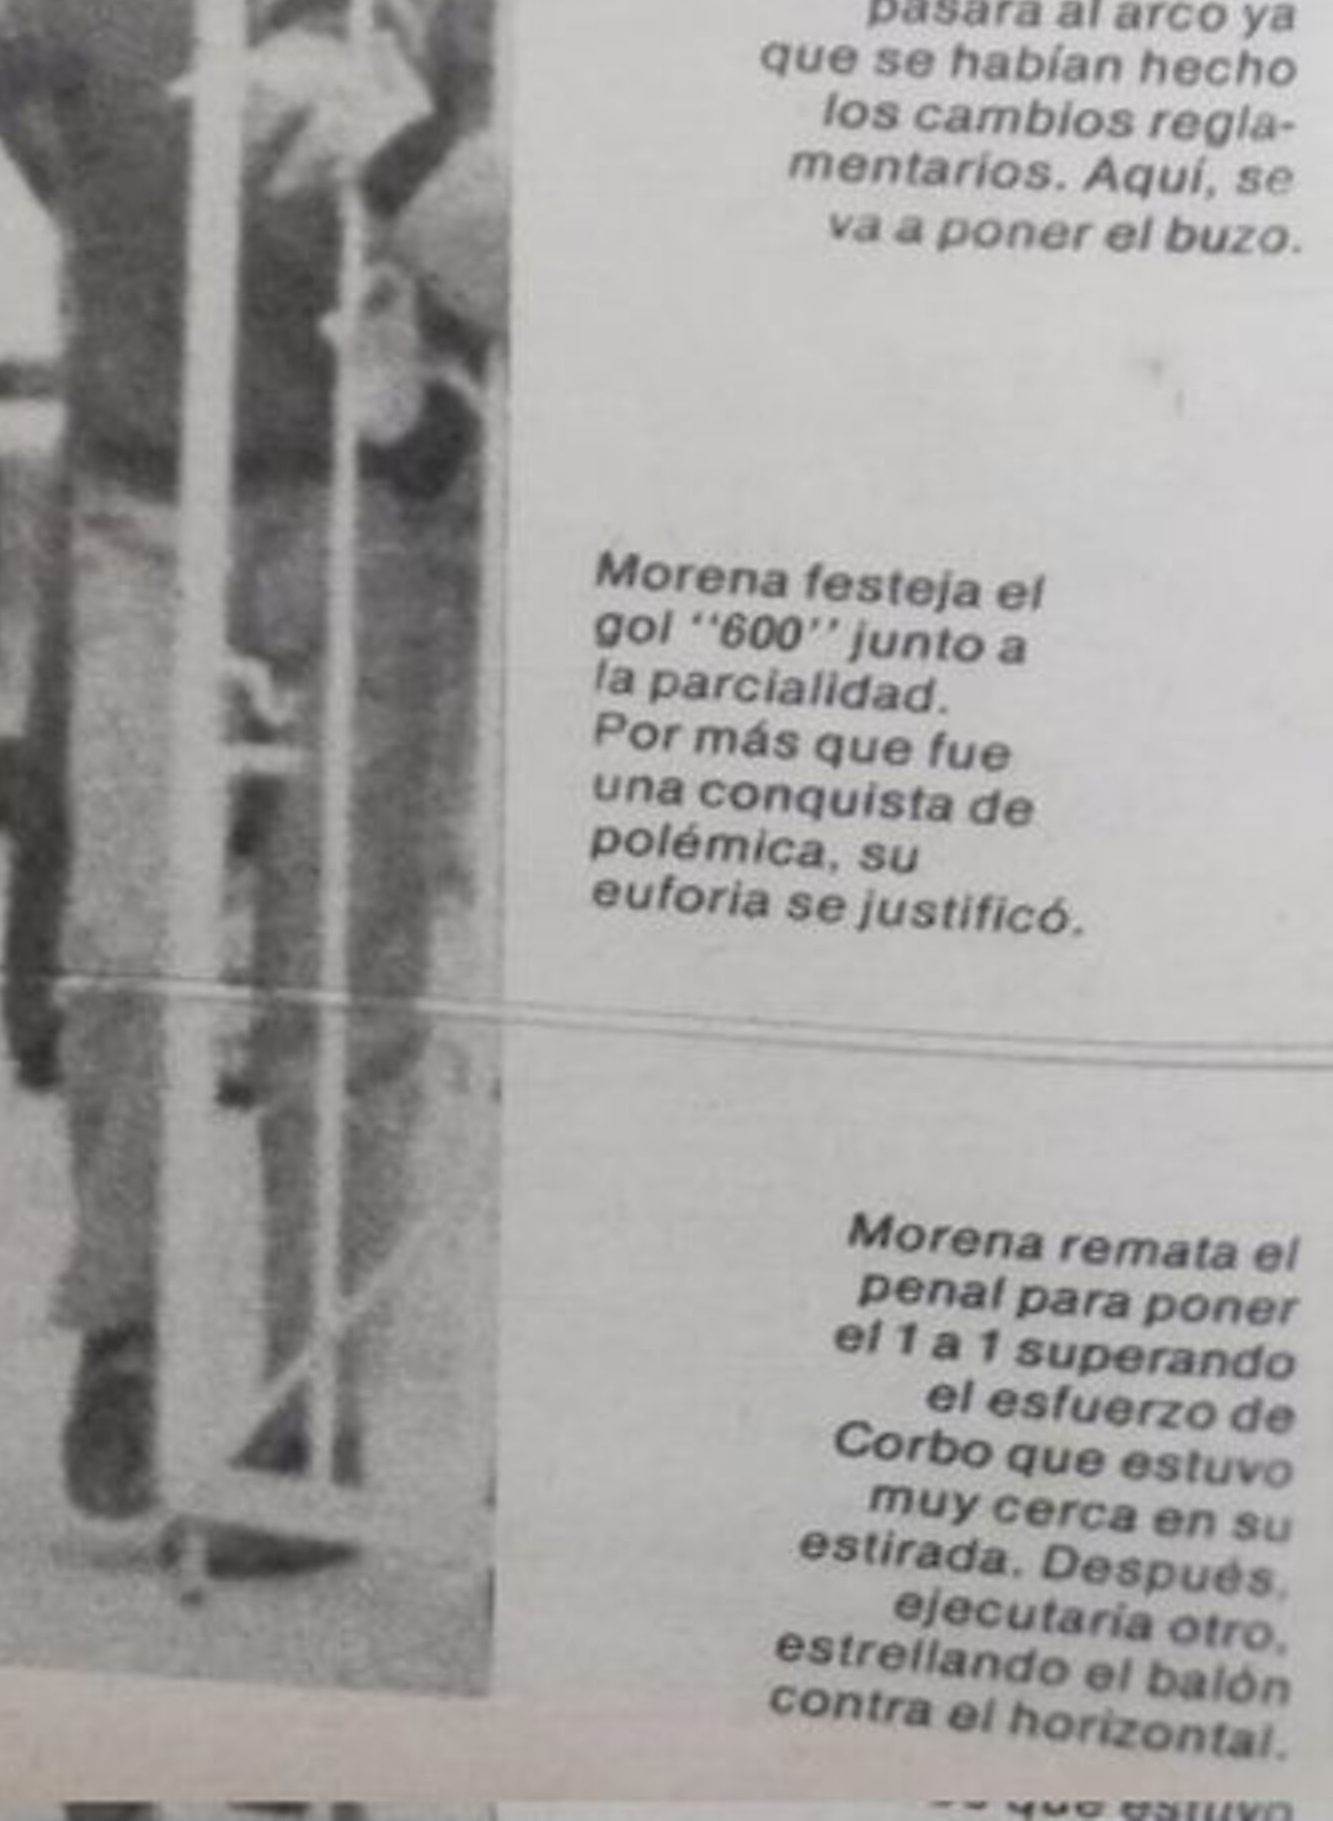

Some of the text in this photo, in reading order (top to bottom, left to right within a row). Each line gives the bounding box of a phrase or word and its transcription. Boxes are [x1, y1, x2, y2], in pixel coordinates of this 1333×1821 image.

[1115, 2, 1227, 32] arco
[1244, 3, 1296, 39] ya
[759, 41, 1297, 87] que se habían hecho
[823, 93, 1295, 148] los cambios regla-
[788, 151, 1065, 190] mentarios.
[1237, 166, 1294, 195] se
[829, 213, 1301, 255] va a poner el buzo.
[595, 549, 1046, 613] Morena festeja el
[595, 611, 673, 649] gol
[848, 621, 985, 663] junto
[997, 635, 1027, 665] a
[595, 659, 947, 713] la parcialidad.
[594, 711, 1012, 773] Por más que fue
[593, 773, 1035, 828] una conquista de
[589, 823, 919, 874] polémica, su
[592, 875, 1084, 937] euforia se justificó.
[847, 1211, 1301, 1273] Morena remata el
[857, 1273, 1300, 1327] penal para poner
[833, 1319, 1296, 1381] el 1 a 1 superando
[926, 1379, 1296, 1435] el esfuerzo de
[833, 1420, 1293, 1489] Corbo que estuvo
[869, 1485, 1292, 1543] muy cerca en su
[799, 1531, 1020, 1576] estirada.
[775, 1632, 1291, 1705] estrellando el balón
[768, 1685, 1285, 1760] contra el horizontal.
